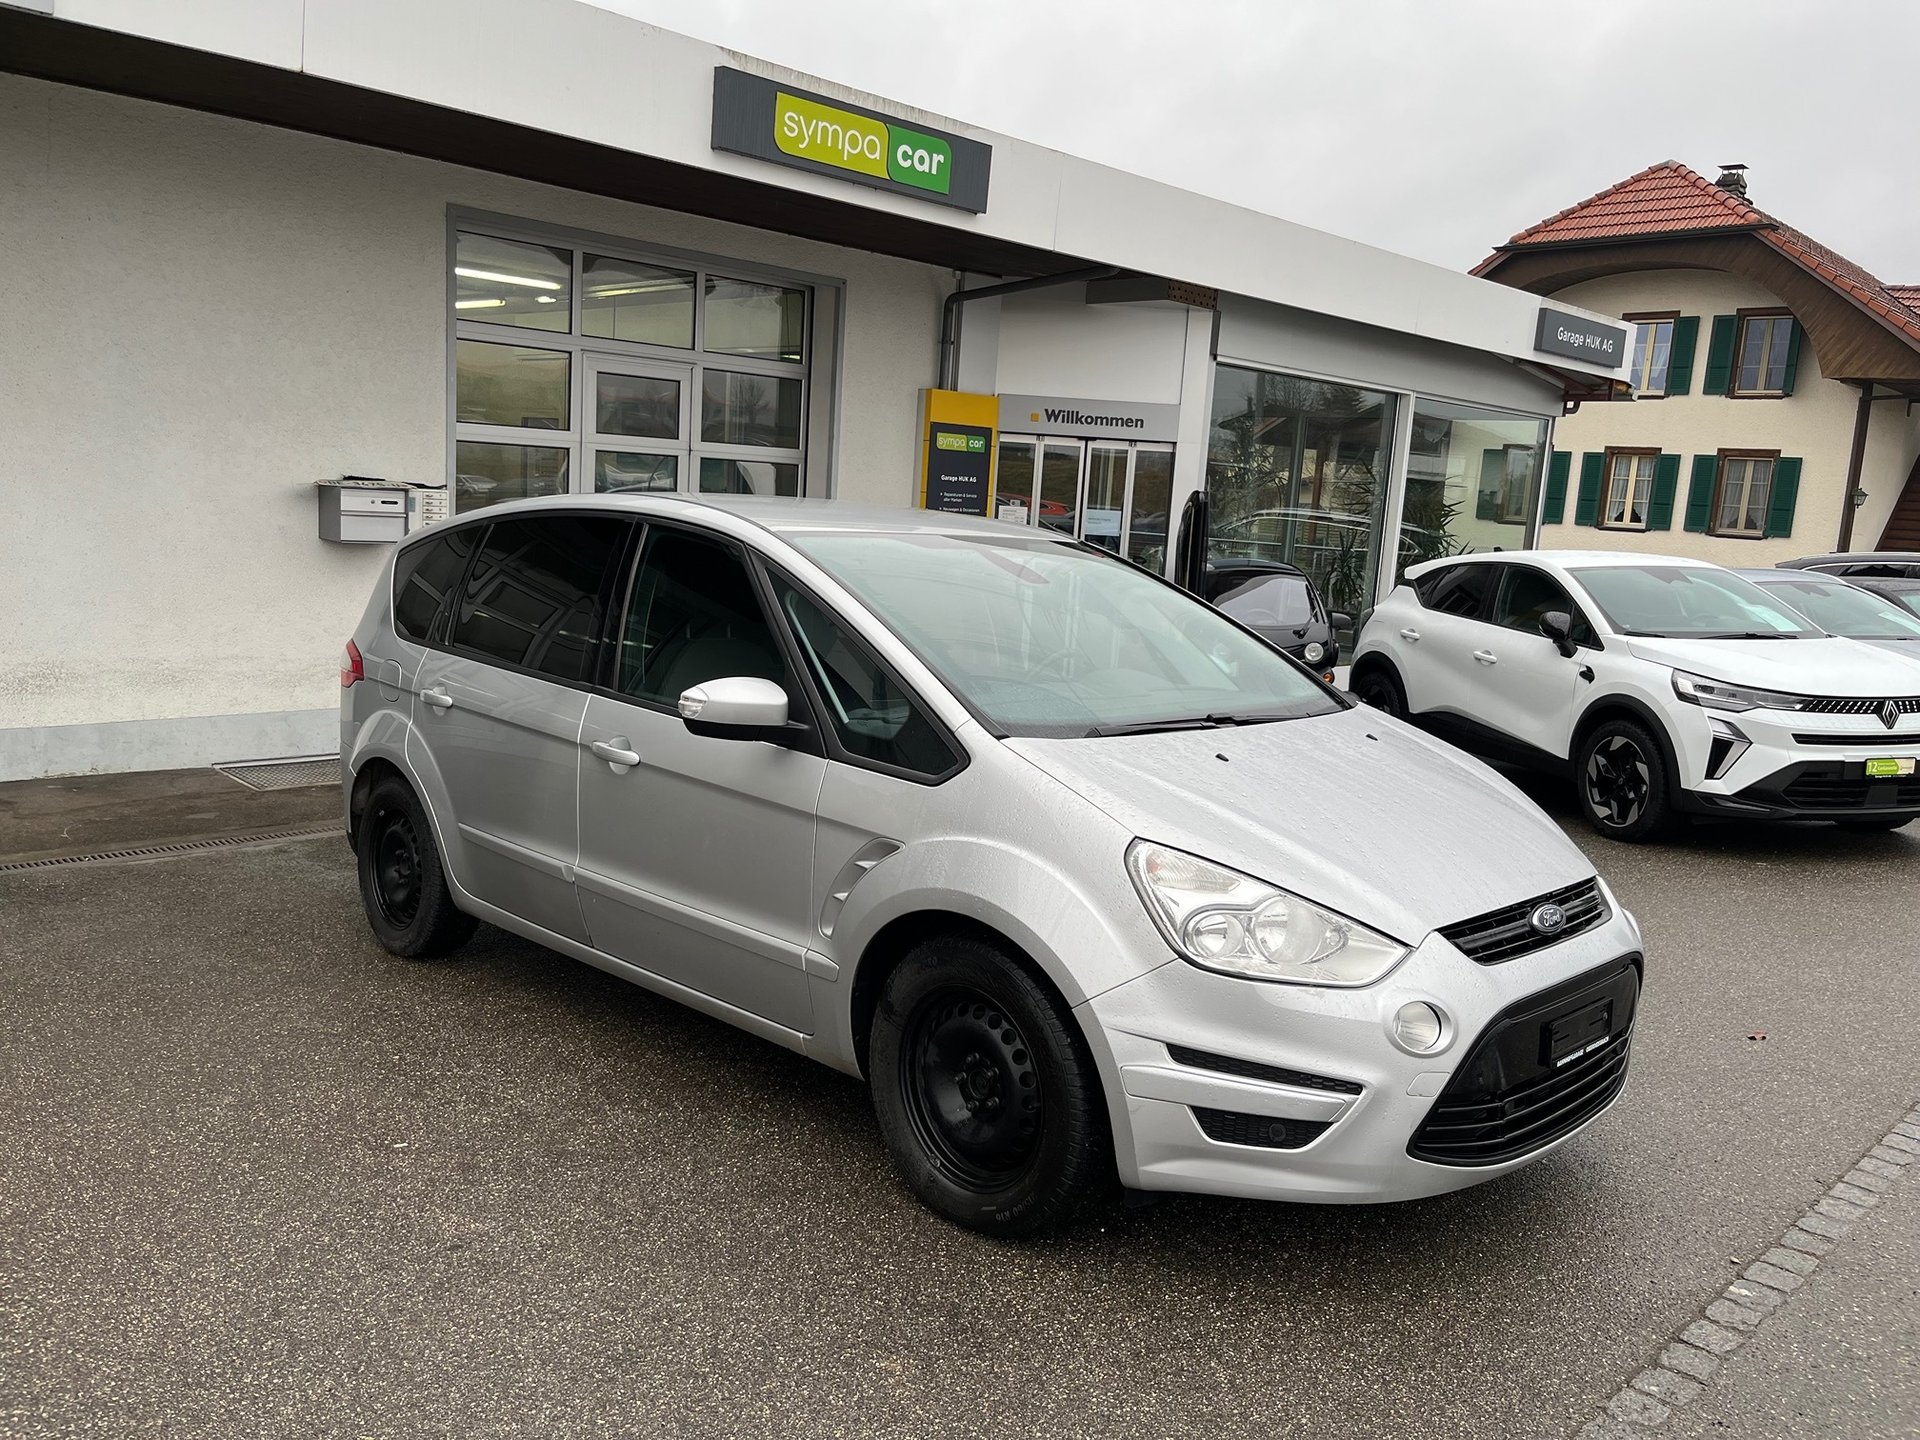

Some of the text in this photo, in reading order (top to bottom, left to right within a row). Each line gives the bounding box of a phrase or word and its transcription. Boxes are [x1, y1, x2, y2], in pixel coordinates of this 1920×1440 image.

[783, 111, 945, 175] sympa car
[1557, 326, 1614, 353] Garage HUK AG
[1044, 408, 1145, 429] Willkommen
[938, 436, 984, 449] sympa car
[940, 474, 958, 483] Garage
[1868, 762, 1878, 772] 12
[1542, 909, 1561, 927] Ford
